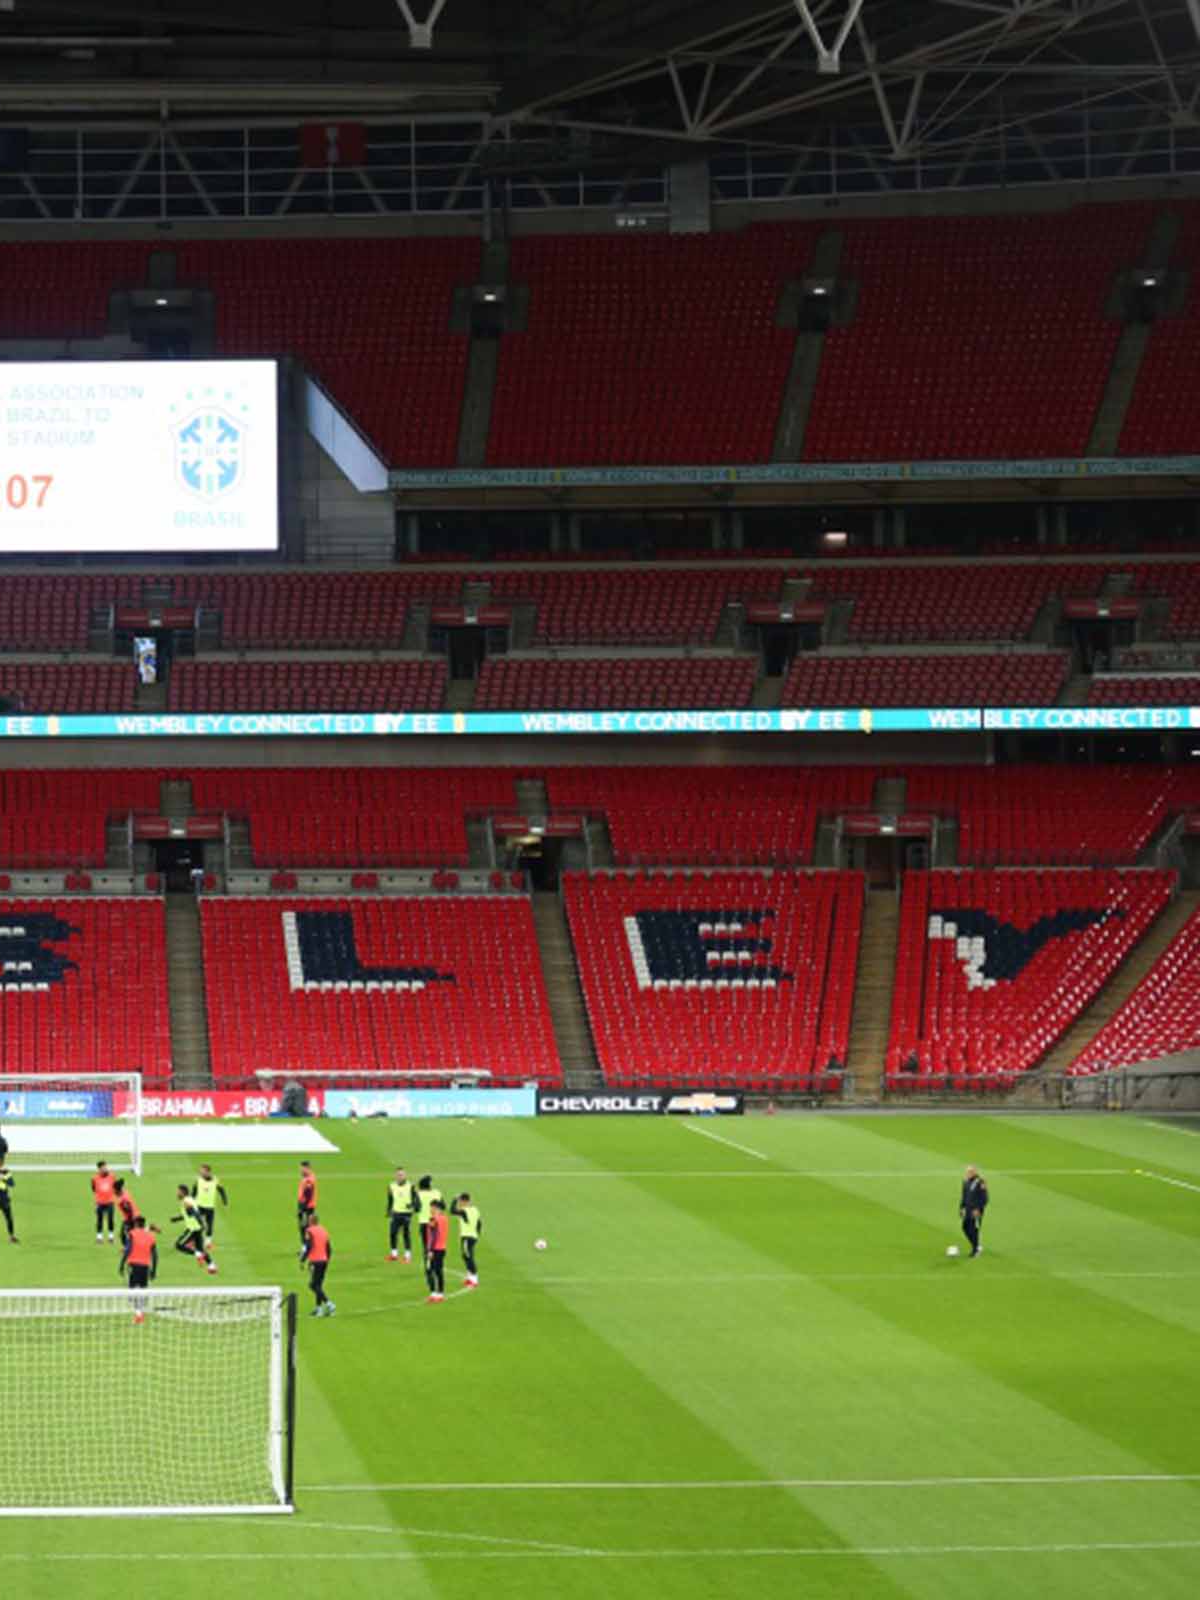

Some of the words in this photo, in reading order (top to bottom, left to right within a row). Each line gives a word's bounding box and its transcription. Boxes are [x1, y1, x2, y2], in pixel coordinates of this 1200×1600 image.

[9, 384, 145, 400] ASSOCIATION
[7, 430, 97, 446] STADIUM
[6, 716, 34, 735] EE
[115, 714, 223, 734] WEMBLEY
[229, 714, 365, 733] CONNECTED
[412, 714, 440, 732] EE
[521, 712, 629, 731] WEMBLEY
[635, 711, 771, 731] CONNECTED
[818, 711, 845, 729] EE
[928, 709, 1039, 729] WEMBLEY
[1044, 708, 1181, 728] CONNECTED
[141, 1097, 215, 1116] BRAHMA
[245, 1097, 321, 1117] BRAA
[540, 1095, 661, 1111] CHEVROLET
